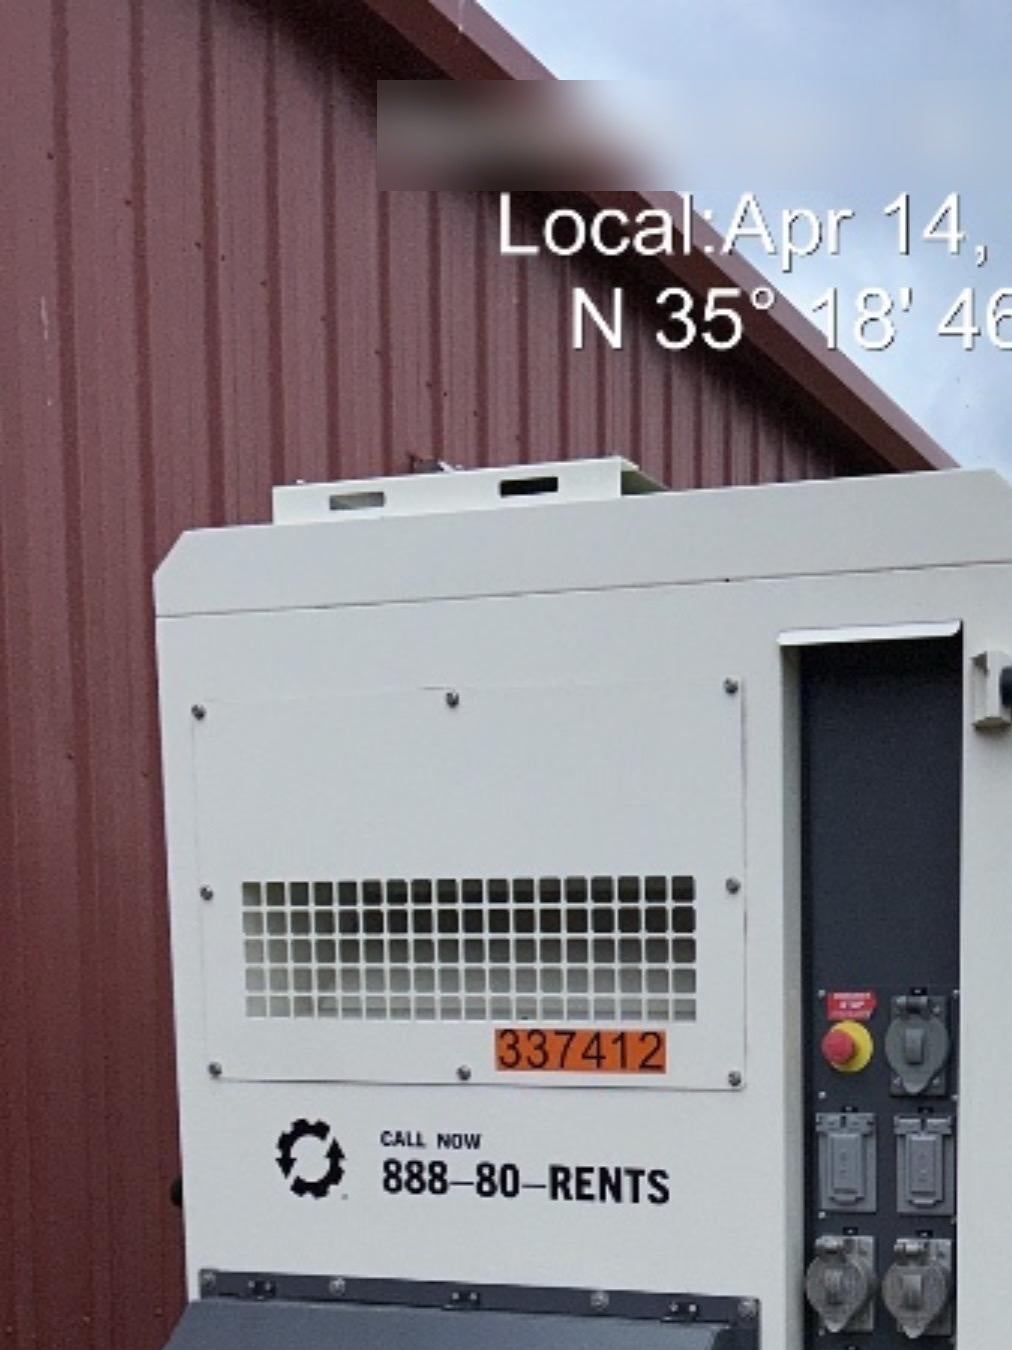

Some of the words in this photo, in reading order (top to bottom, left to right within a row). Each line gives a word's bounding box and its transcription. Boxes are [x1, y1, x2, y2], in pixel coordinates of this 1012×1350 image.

[498, 1029, 664, 1070] 337412
[380, 1130, 426, 1148] CALL
[437, 1133, 482, 1150] NOW
